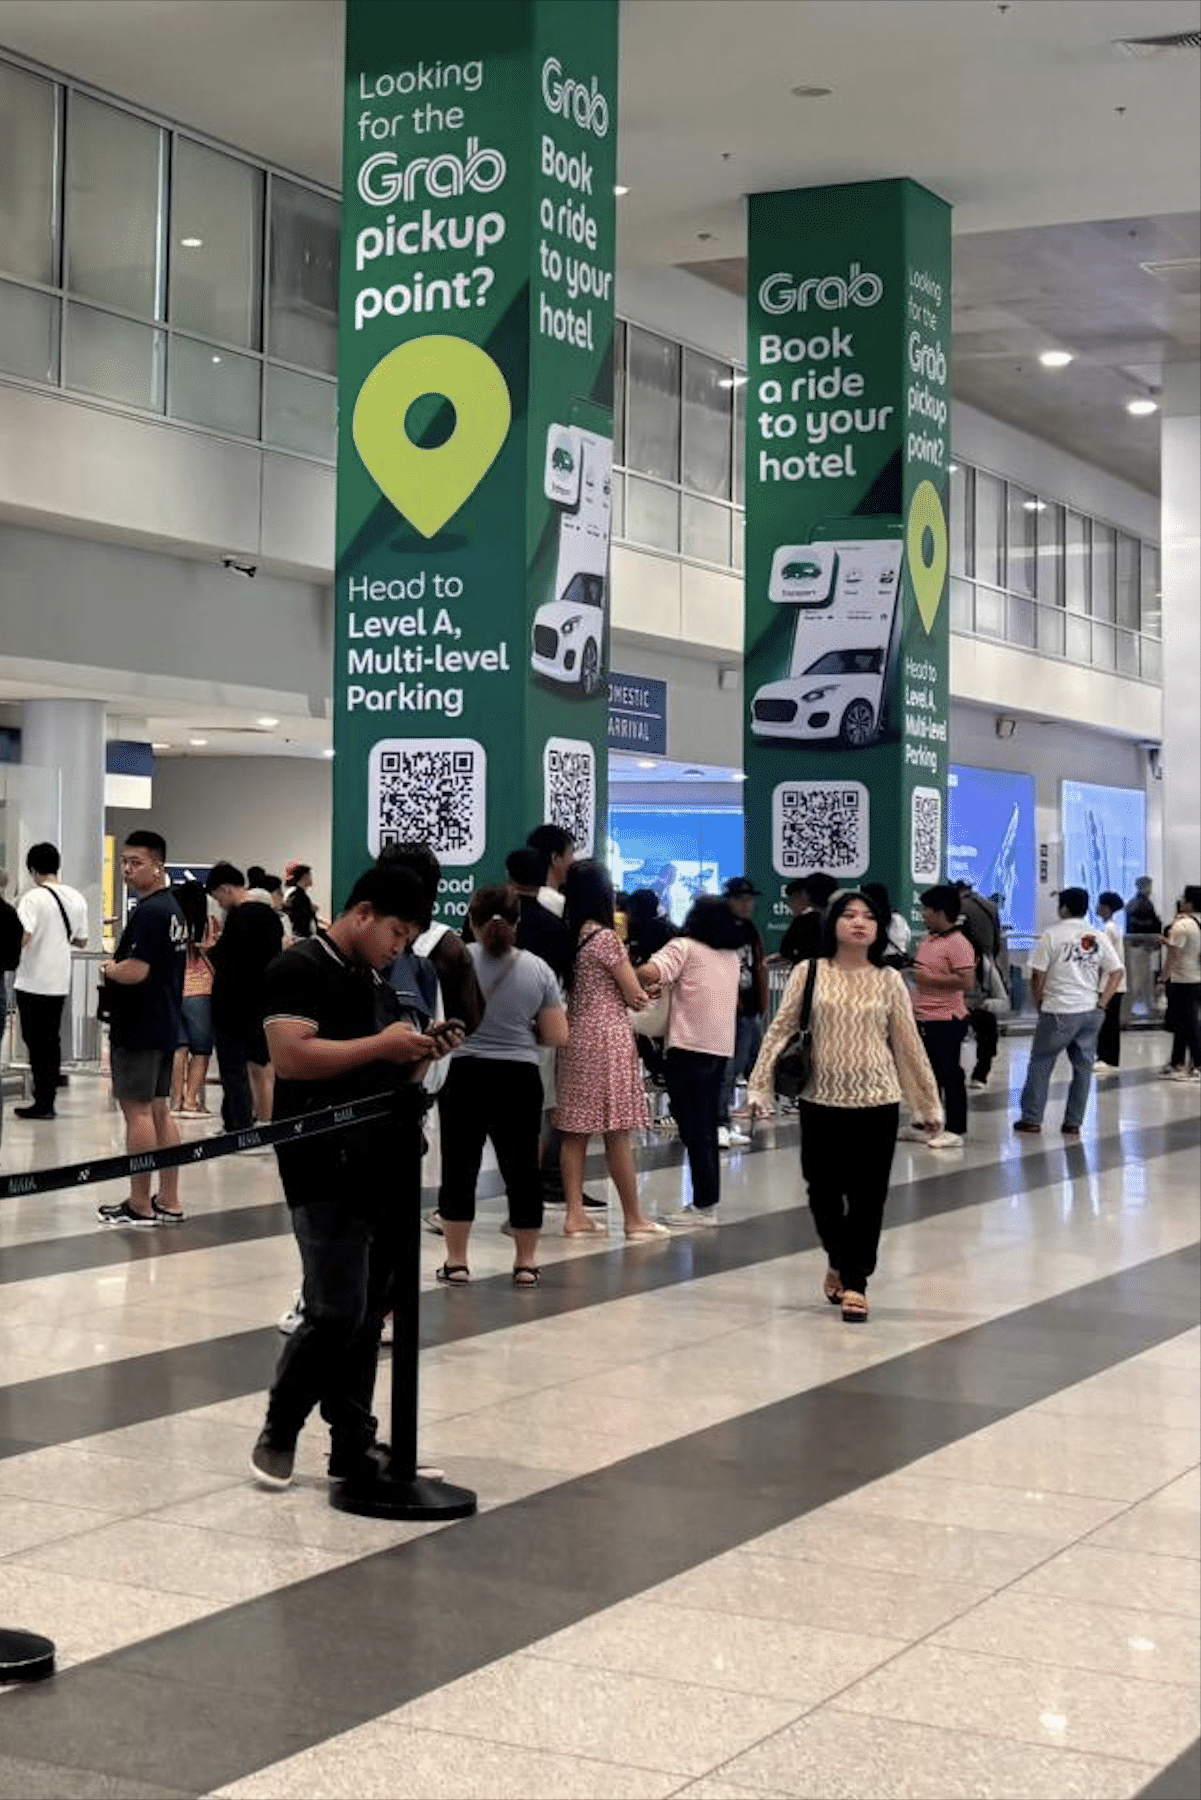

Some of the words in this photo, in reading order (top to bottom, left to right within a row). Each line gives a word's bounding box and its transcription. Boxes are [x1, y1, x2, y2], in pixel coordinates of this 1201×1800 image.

[360, 61, 483, 99] Looking
[542, 57, 609, 137] Grab
[358, 111, 403, 141] for
[412, 103, 464, 134] the
[358, 136, 506, 206] Grab
[542, 135, 592, 195] Book
[356, 209, 506, 271] pickup
[541, 198, 553, 232] a
[558, 198, 597, 250] ride
[540, 240, 562, 282] to
[567, 257, 612, 300] your
[758, 262, 883, 314] Grab
[909, 267, 941, 307] Looking
[355, 266, 495, 330] point?
[540, 292, 593, 351] hotel
[760, 327, 854, 365] Book
[909, 331, 947, 386] Grab
[758, 380, 783, 404] a
[791, 366, 865, 402] ride
[758, 412, 797, 439] to
[806, 406, 893, 443] your
[908, 382, 947, 431] pickup
[759, 444, 857, 482] hotel
[908, 430, 945, 468] point?
[349, 572, 425, 602] Head
[432, 574, 463, 598] to
[348, 608, 427, 638] Level
[433, 609, 462, 639] A,
[347, 642, 510, 675] Multi-level
[905, 656, 928, 681] Head
[347, 684, 463, 717] Parking
[608, 684, 650, 708] OMESTIC
[905, 684, 928, 709] Level
[608, 717, 650, 741] ARRIVAL
[905, 743, 937, 773] Parking
[444, 901, 469, 916] no
